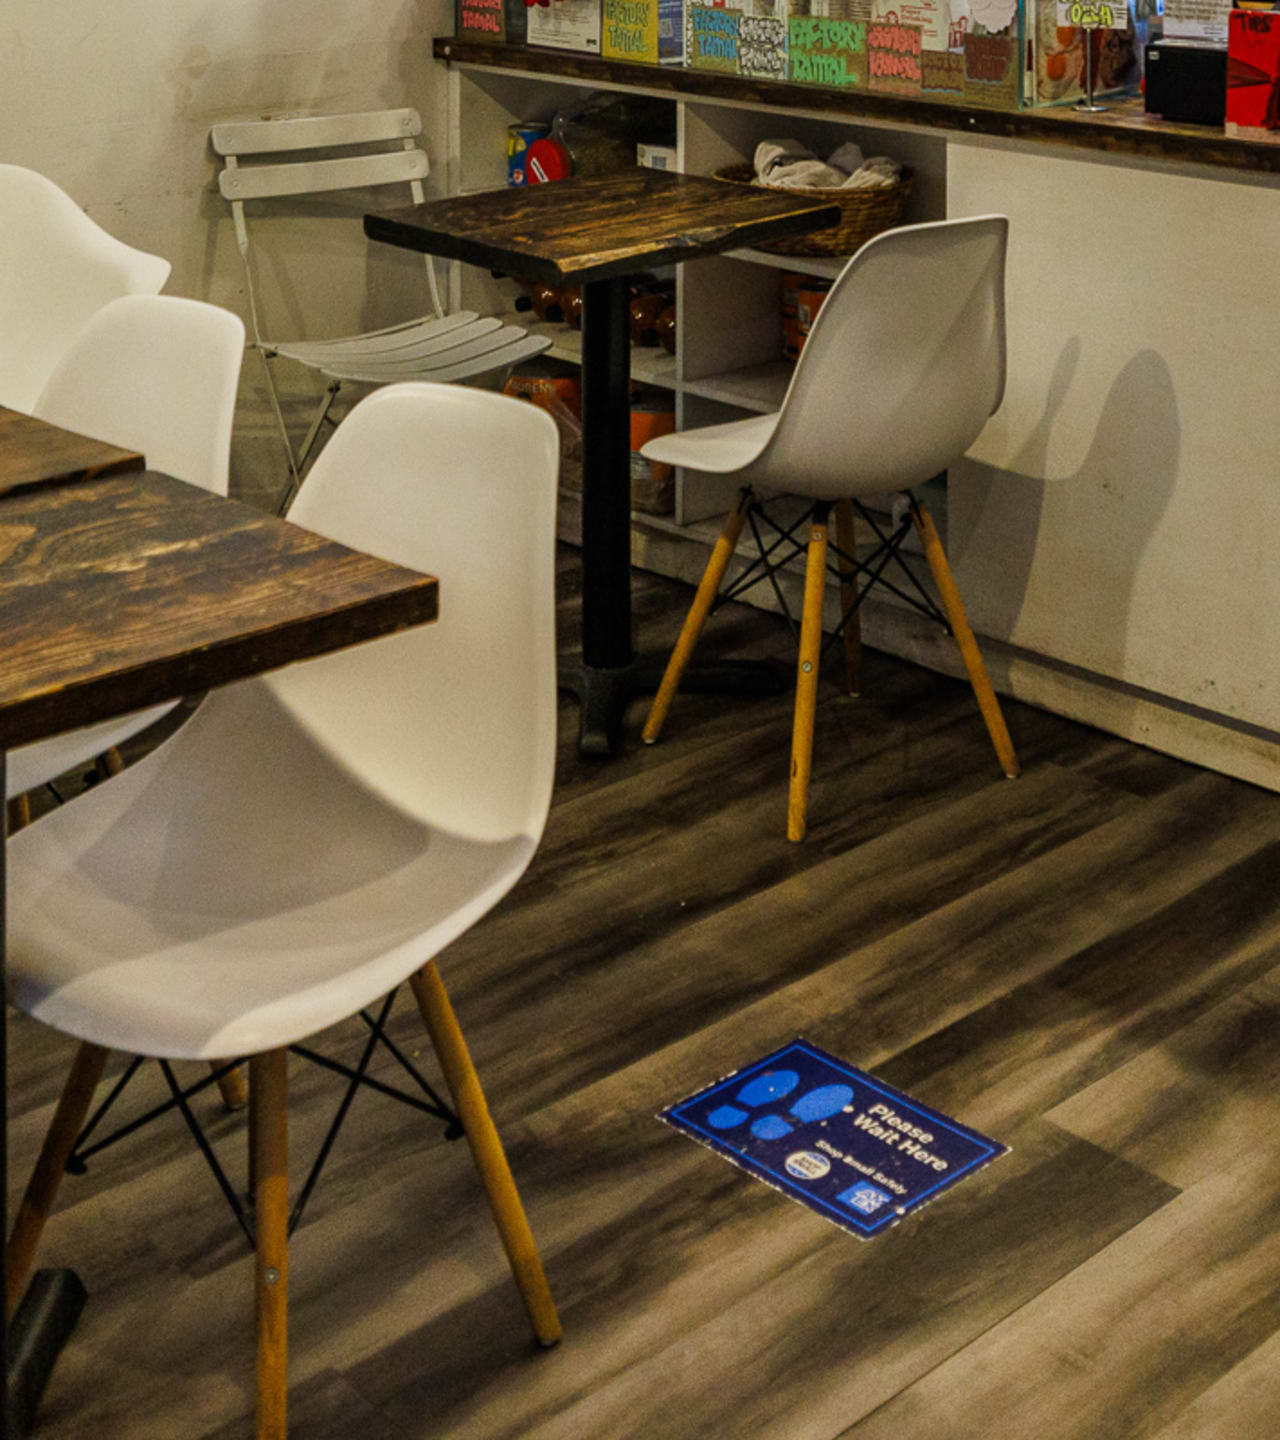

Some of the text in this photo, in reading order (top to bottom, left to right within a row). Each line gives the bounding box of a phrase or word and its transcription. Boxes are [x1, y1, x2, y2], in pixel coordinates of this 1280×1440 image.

[1235, 15, 1273, 33] TIPS
[853, 1114, 949, 1173] Wait Here
[868, 1103, 934, 1145] Please
